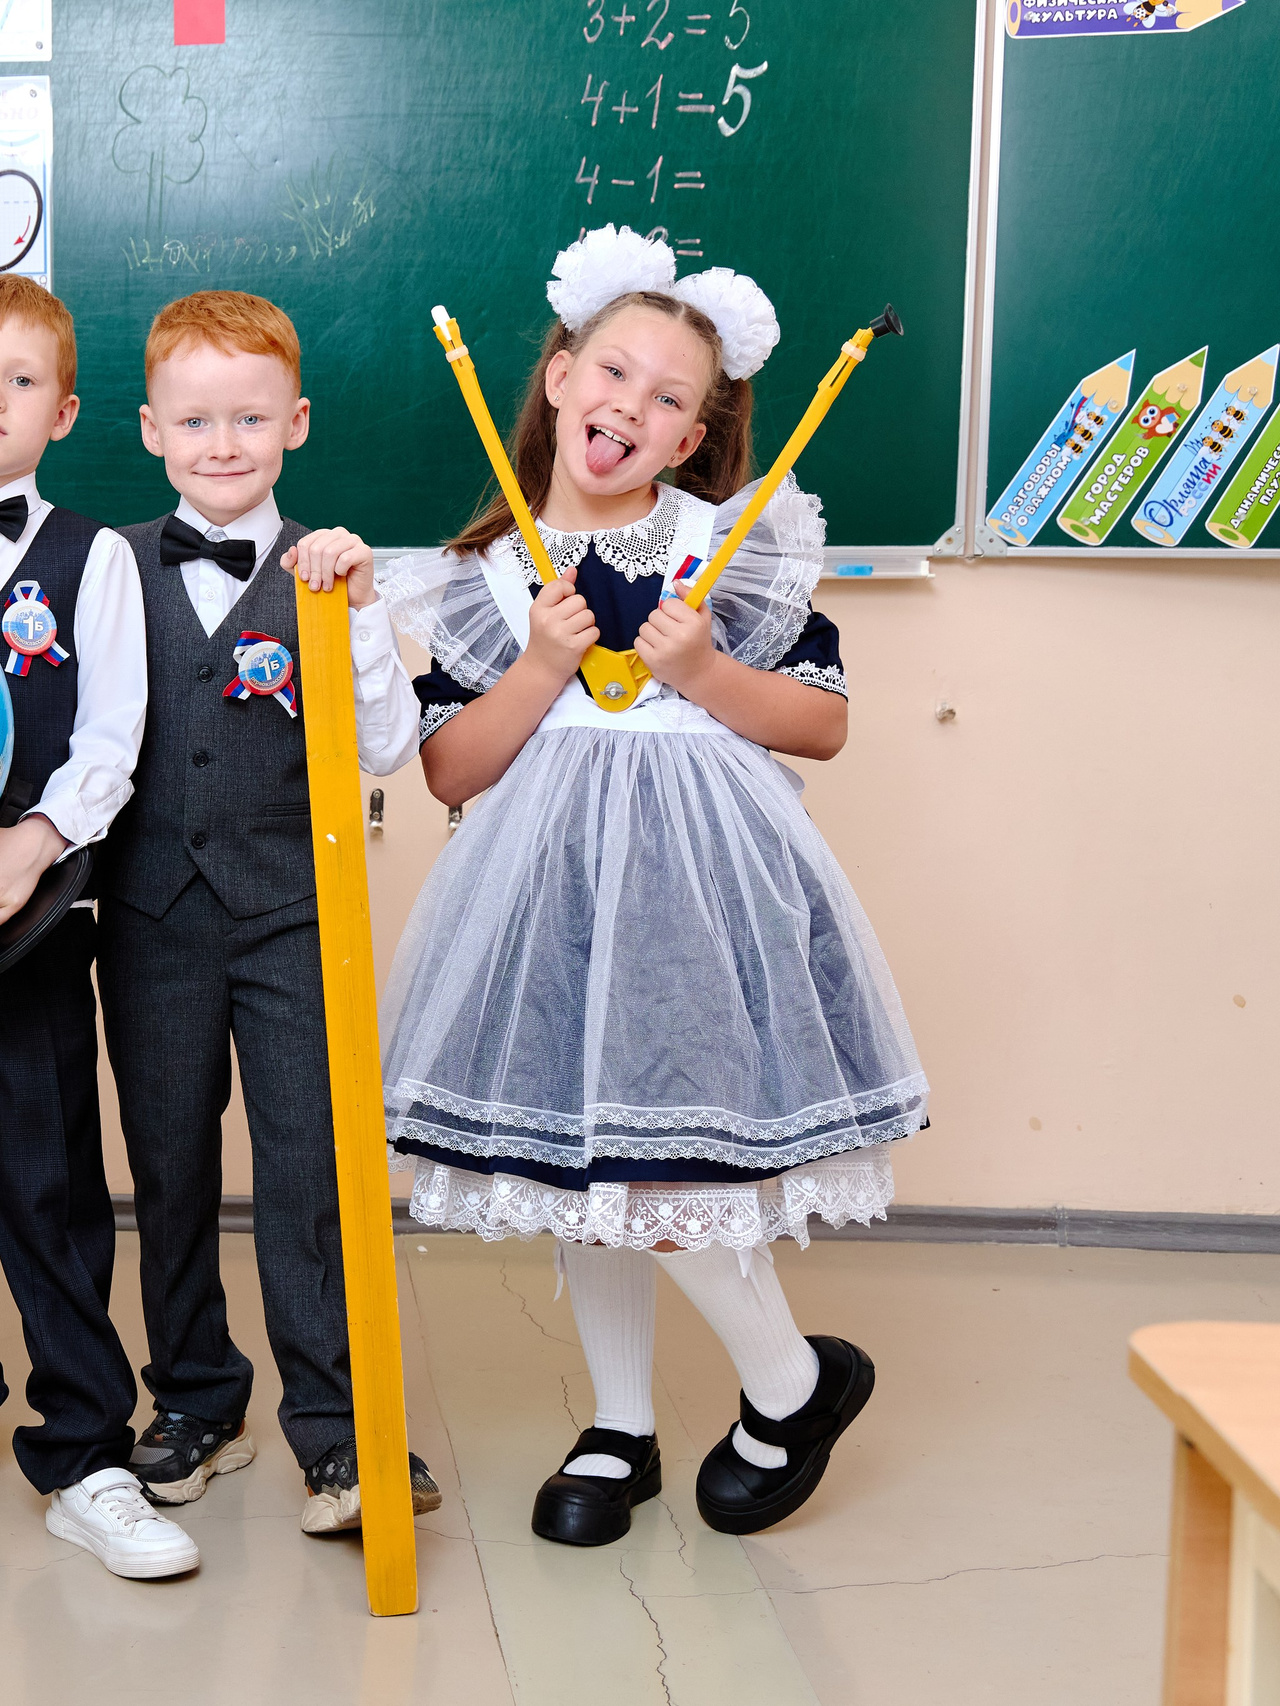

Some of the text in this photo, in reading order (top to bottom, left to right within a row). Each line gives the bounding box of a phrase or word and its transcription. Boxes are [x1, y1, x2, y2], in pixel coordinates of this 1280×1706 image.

[1029, 8, 1118, 23] КУЛЬТУРА
[1001, 443, 1062, 523] РАЗГОВОРЫ
[1016, 455, 1072, 527] О ВАЖНОМ
[1084, 453, 1127, 503] ГОРОД
[1089, 446, 1149, 526] МАСТЕРОВ
[1144, 457, 1212, 527] Орлята
[1179, 463, 1222, 517] РОССИИ
